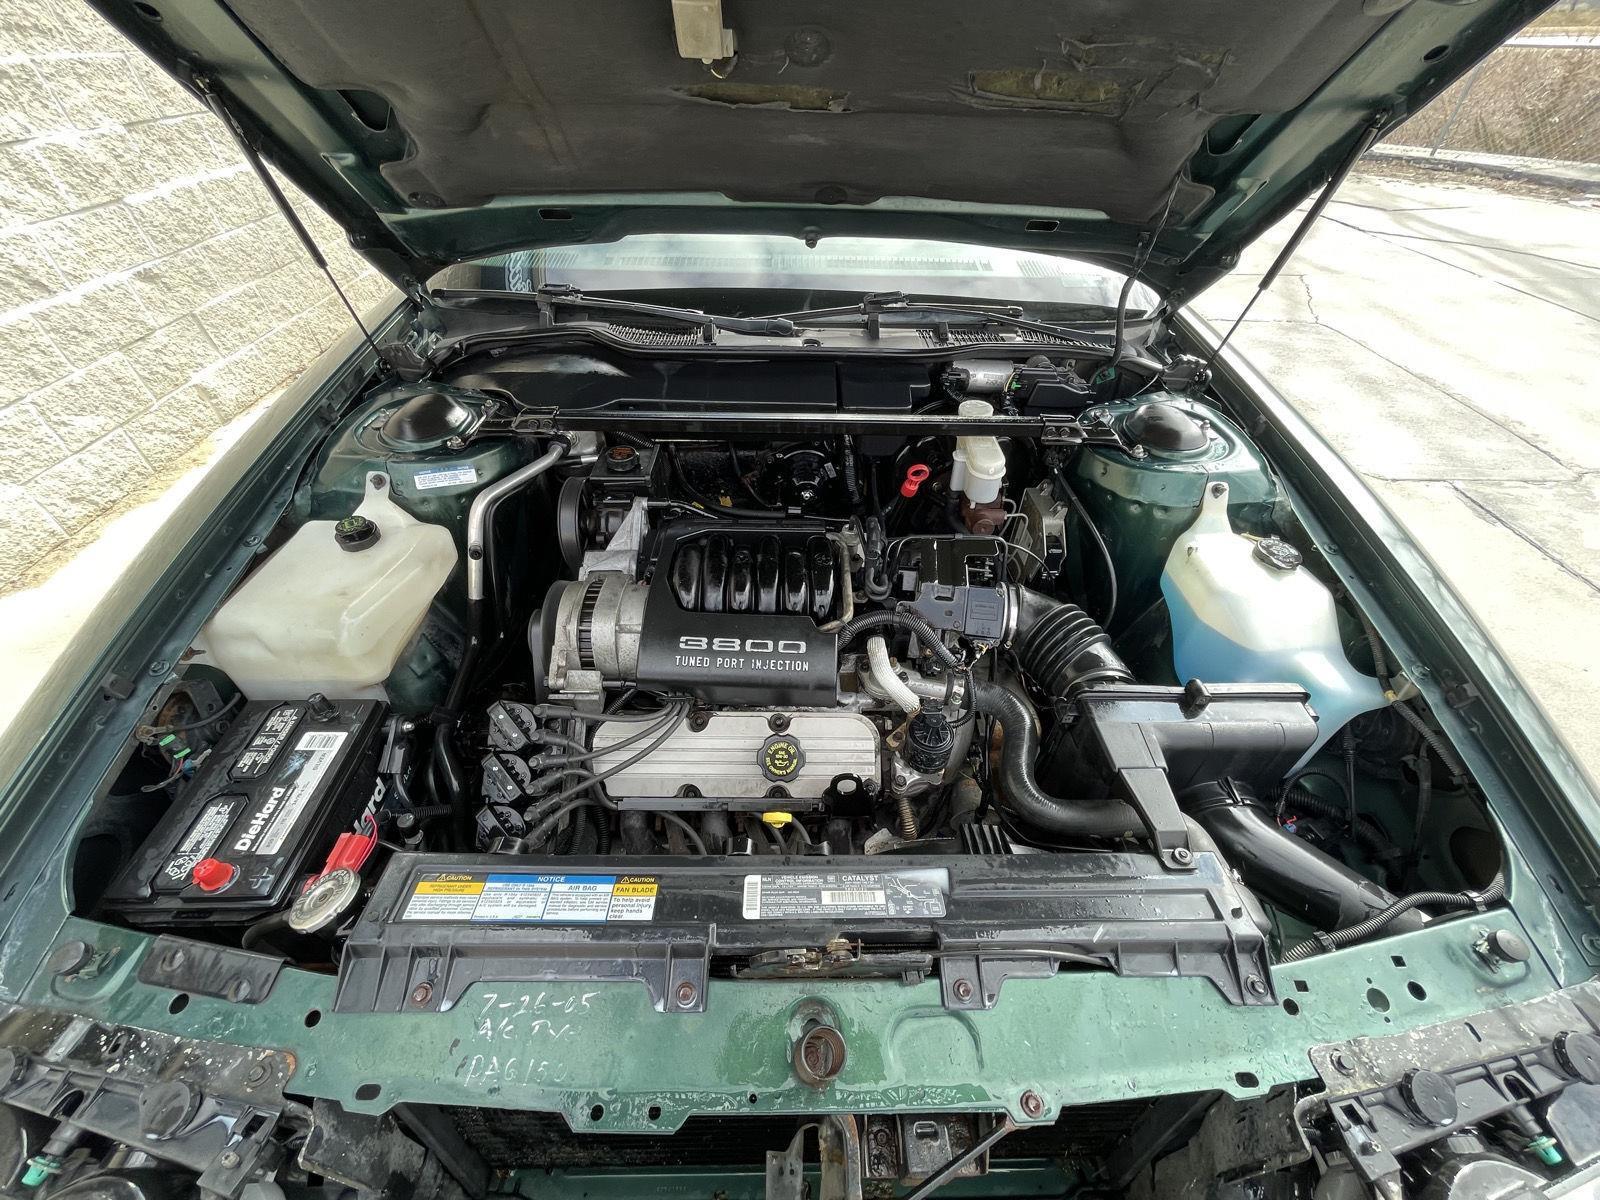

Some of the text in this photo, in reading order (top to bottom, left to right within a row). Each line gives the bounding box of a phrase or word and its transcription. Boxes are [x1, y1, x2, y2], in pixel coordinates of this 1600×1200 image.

[679, 636, 807, 654] 3800
[675, 656, 809, 672] TUNED PORT INJECTION
[768, 742, 788, 754] ENGINE
[234, 787, 285, 851] DieHard
